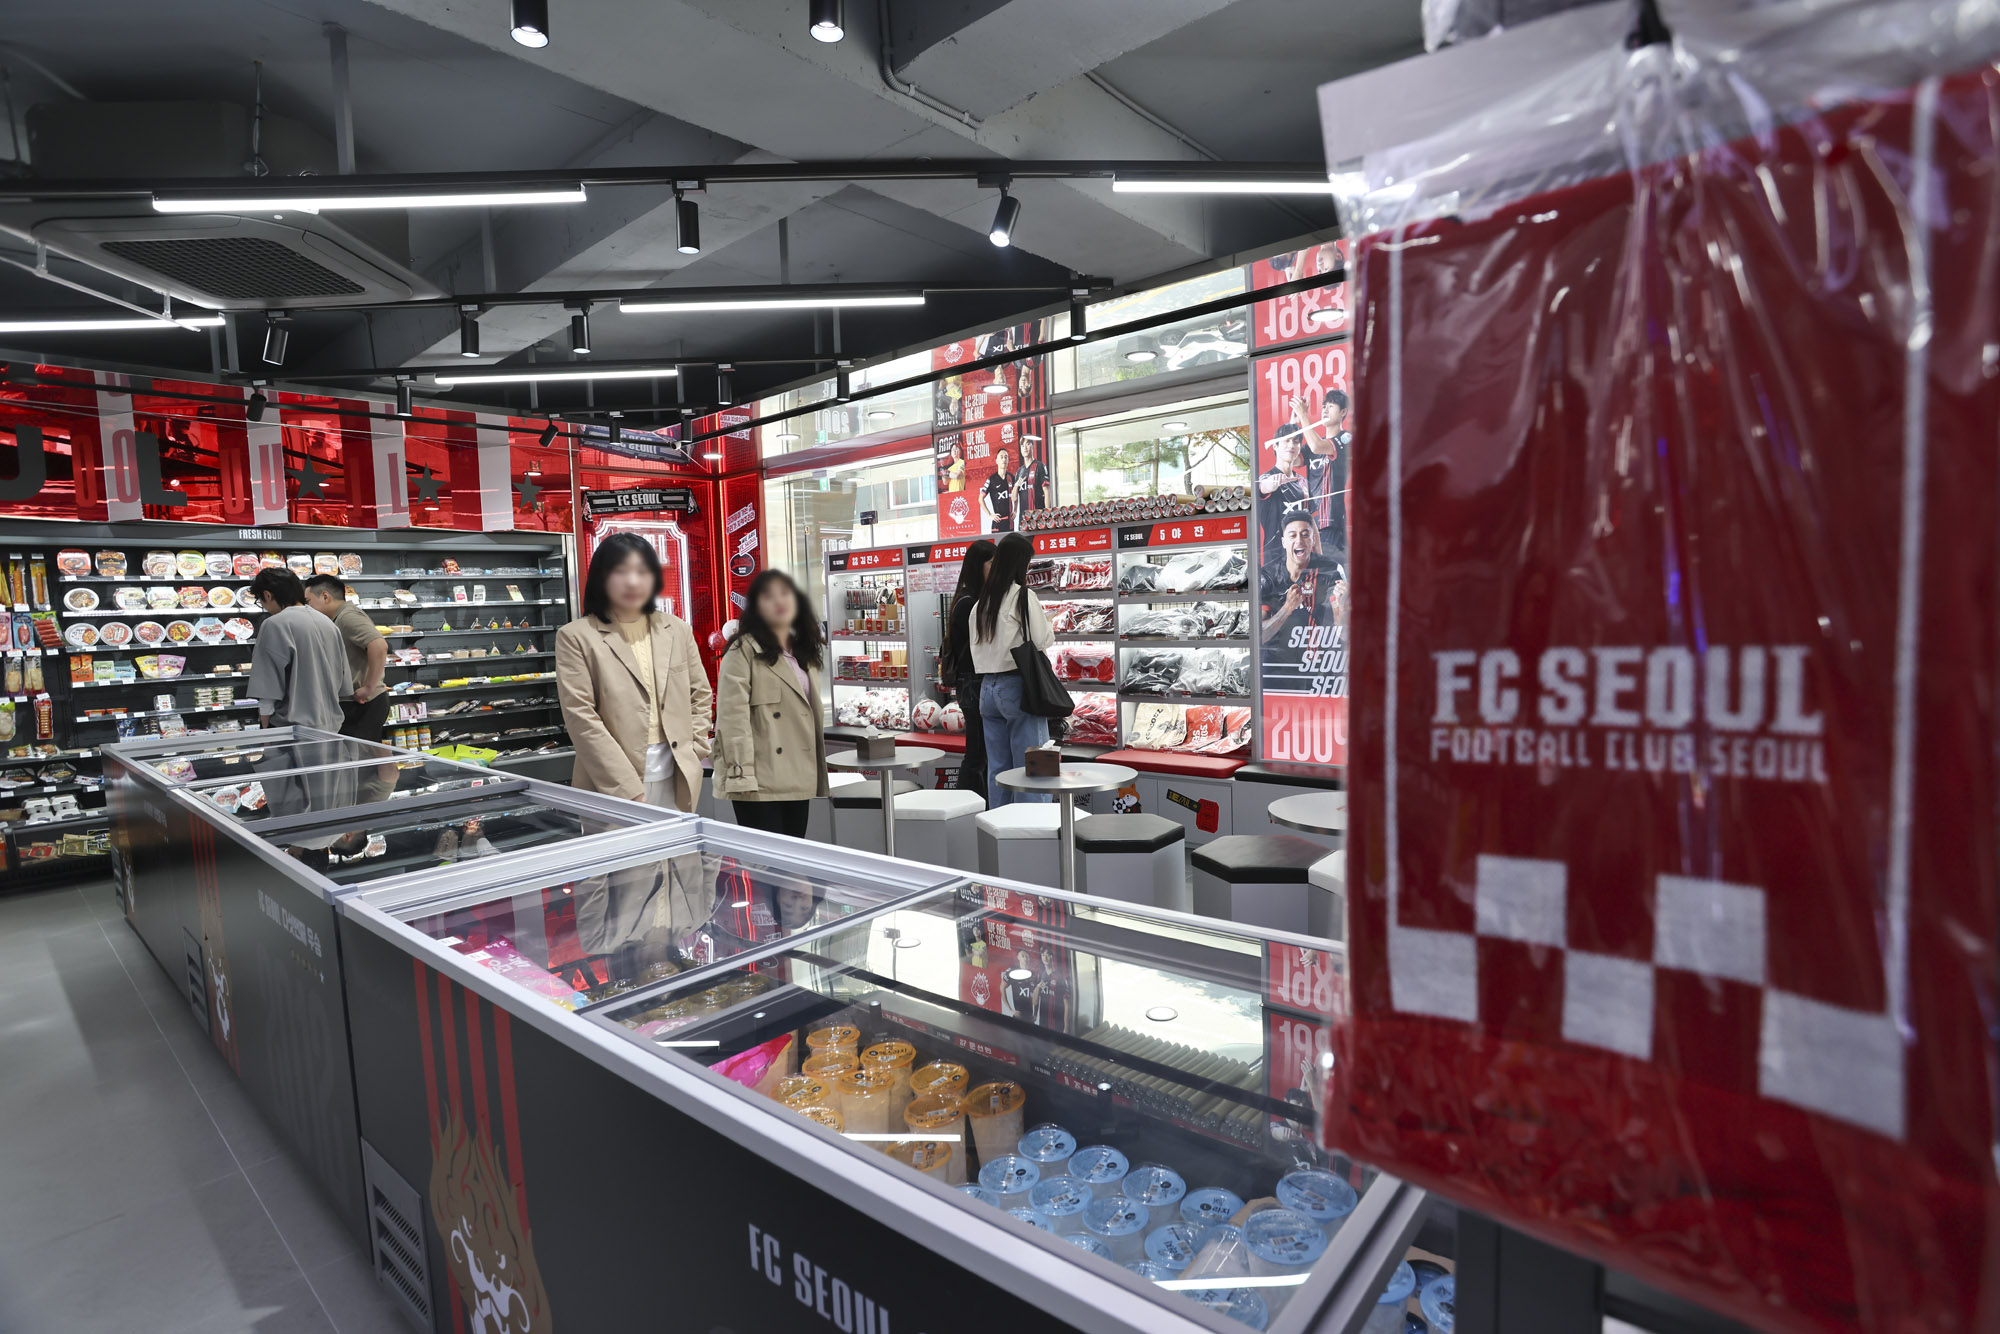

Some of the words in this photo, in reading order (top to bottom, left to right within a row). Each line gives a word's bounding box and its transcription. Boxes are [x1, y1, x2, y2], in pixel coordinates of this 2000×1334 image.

[1265, 349, 1347, 424] 1983
[966, 432, 976, 446] WE
[976, 430, 986, 444] ARE
[967, 446, 974, 460] FC
[974, 443, 991, 458] SEOUL
[617, 494, 630, 507] FC
[631, 493, 662, 506] SEOUL
[238, 529, 261, 540] FRESH
[263, 530, 282, 540] FOOD
[1160, 529, 1166, 540] 5
[1171, 528, 1182, 539] 야
[1194, 525, 1205, 538] 잔
[1049, 537, 1077, 549] 조영욱
[860, 554, 879, 565] 김진수
[1288, 625, 1343, 648] SEOUL
[1430, 649, 1520, 726] FC
[1536, 645, 1826, 736] SEOUL
[1430, 728, 1591, 768] FOOTBALL
[1605, 732, 1696, 773] CLUB
[1711, 738, 1828, 784] SEOUL
[749, 1223, 782, 1287] FC
